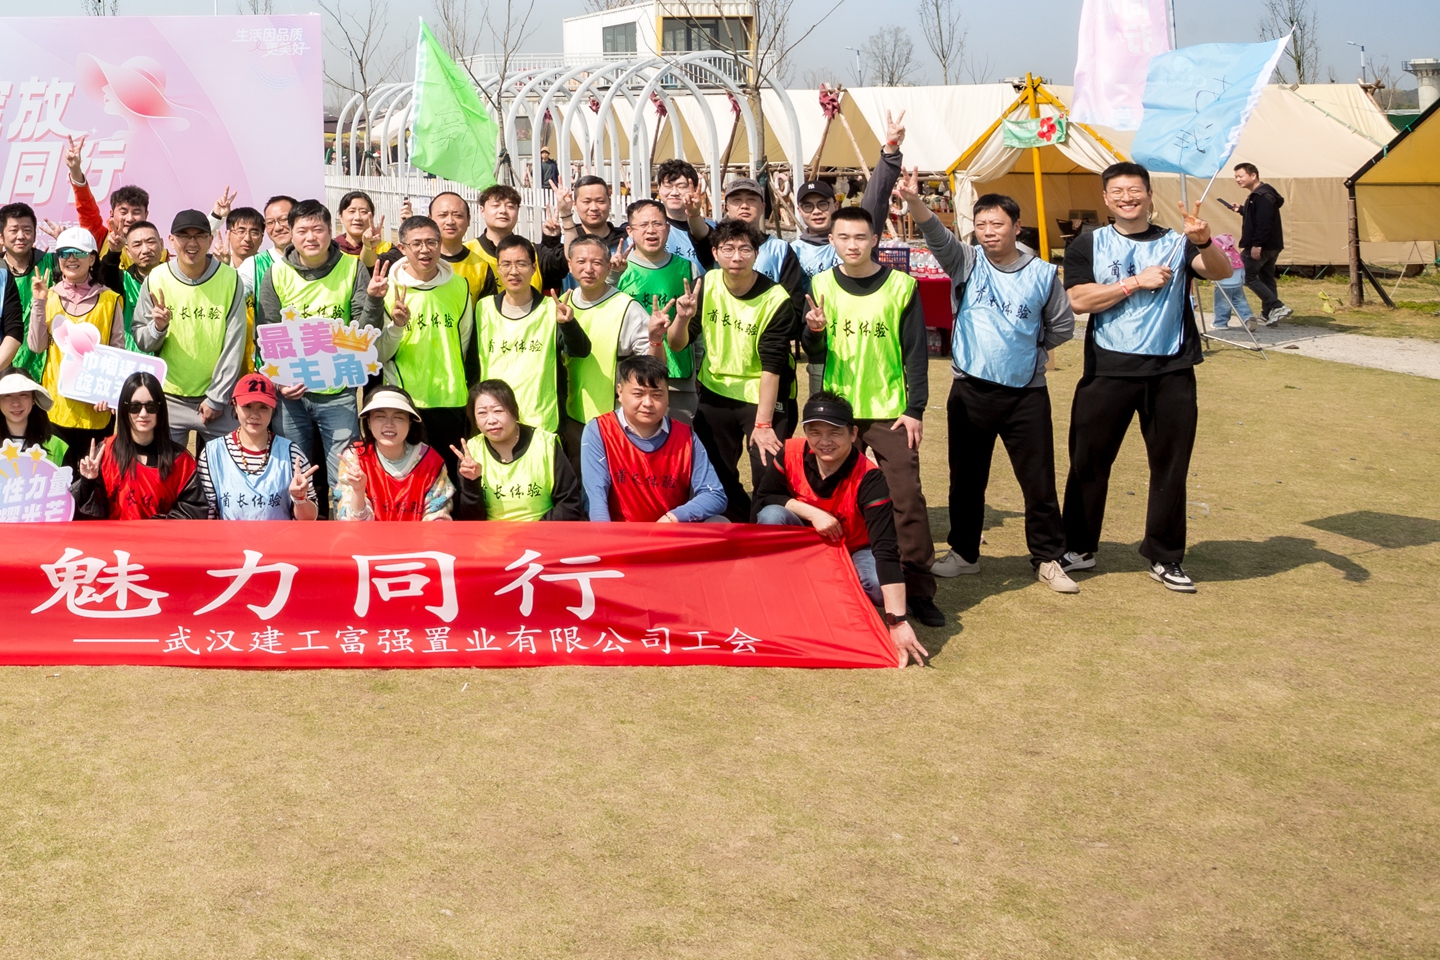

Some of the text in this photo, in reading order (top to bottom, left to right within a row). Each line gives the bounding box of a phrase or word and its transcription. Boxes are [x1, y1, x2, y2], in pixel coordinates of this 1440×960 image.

[231, 28, 303, 42] 生活因品质
[262, 42, 310, 57] 更美好
[260, 321, 338, 359] 最美
[288, 353, 366, 390] 主角
[31, 547, 626, 621] 魅力同行
